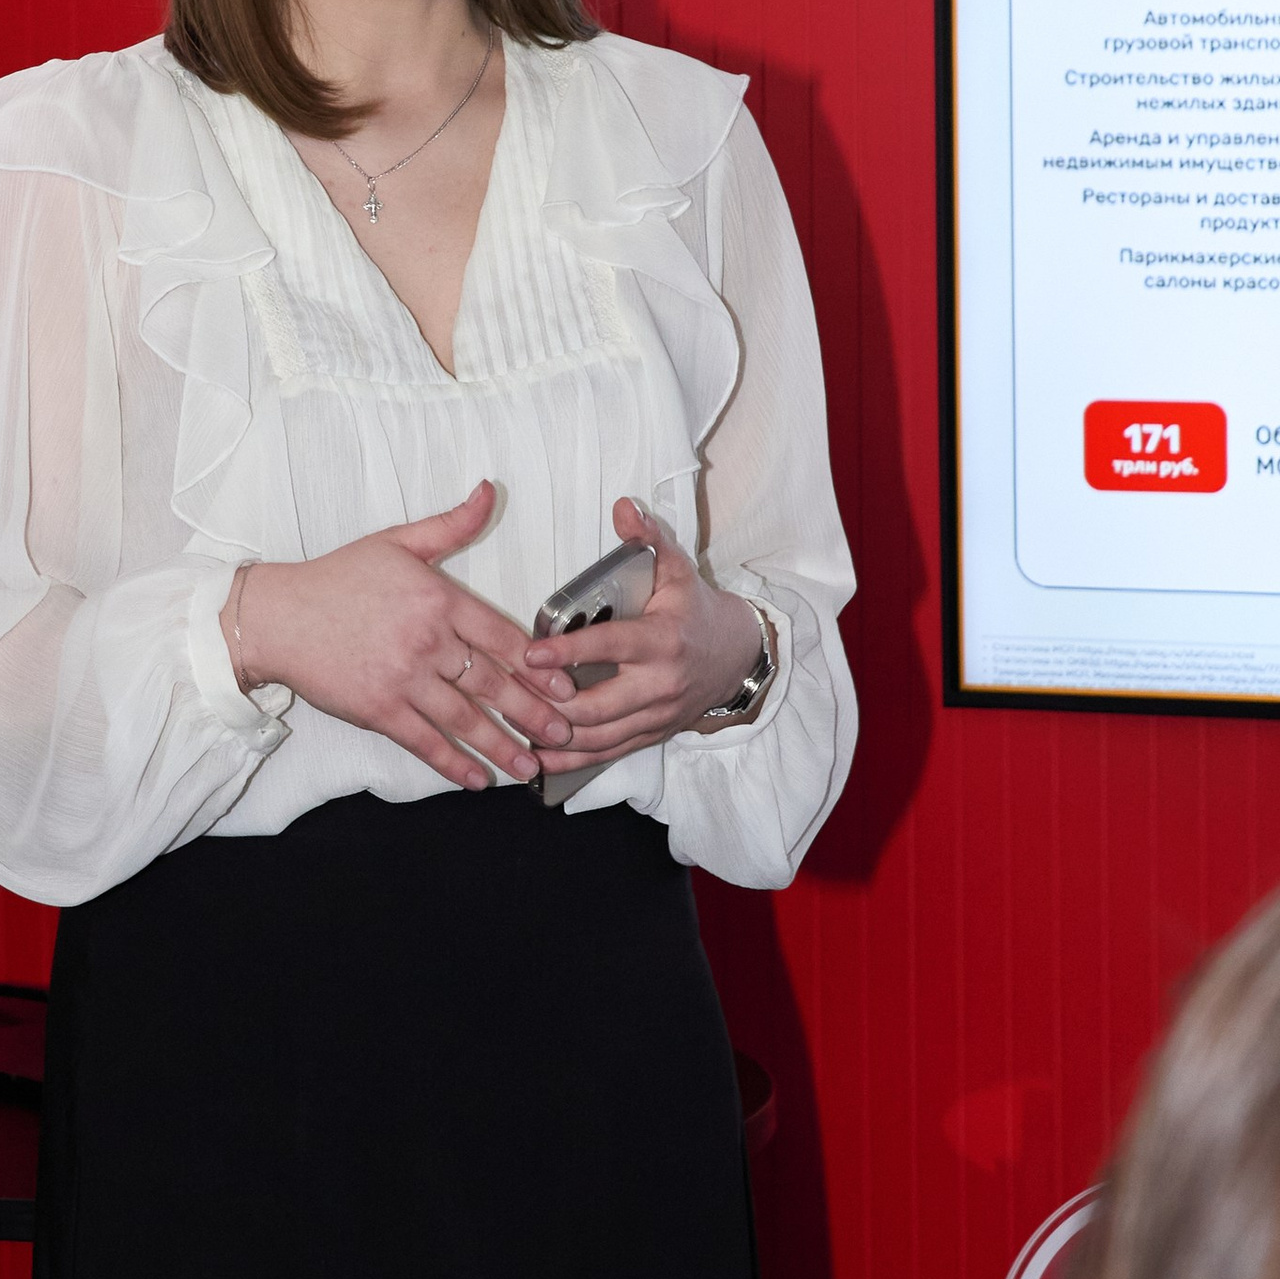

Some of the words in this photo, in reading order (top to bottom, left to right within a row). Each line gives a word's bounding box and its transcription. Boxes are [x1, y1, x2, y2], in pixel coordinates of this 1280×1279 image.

[1143, 10, 1280, 26] Автомобильн
[1103, 34, 1193, 54] грузовой
[1064, 69, 1214, 89] Строительство
[1136, 99, 1225, 110] нежилых
[1233, 98, 1280, 112] здан
[1089, 129, 1162, 148] Аренда
[1167, 134, 1180, 145] и
[1186, 133, 1280, 149] управлен
[1043, 156, 1173, 171] недвижимым
[1179, 158, 1280, 173] имуществ
[1082, 187, 1190, 208] Рестораны
[1196, 194, 1208, 205] и
[1200, 217, 1280, 233] продукт
[1143, 276, 1217, 289] салоны
[1222, 277, 1280, 293] красо
[1123, 423, 1181, 454] 171
[1158, 457, 1199, 479] руб.
[1256, 457, 1280, 475] М
